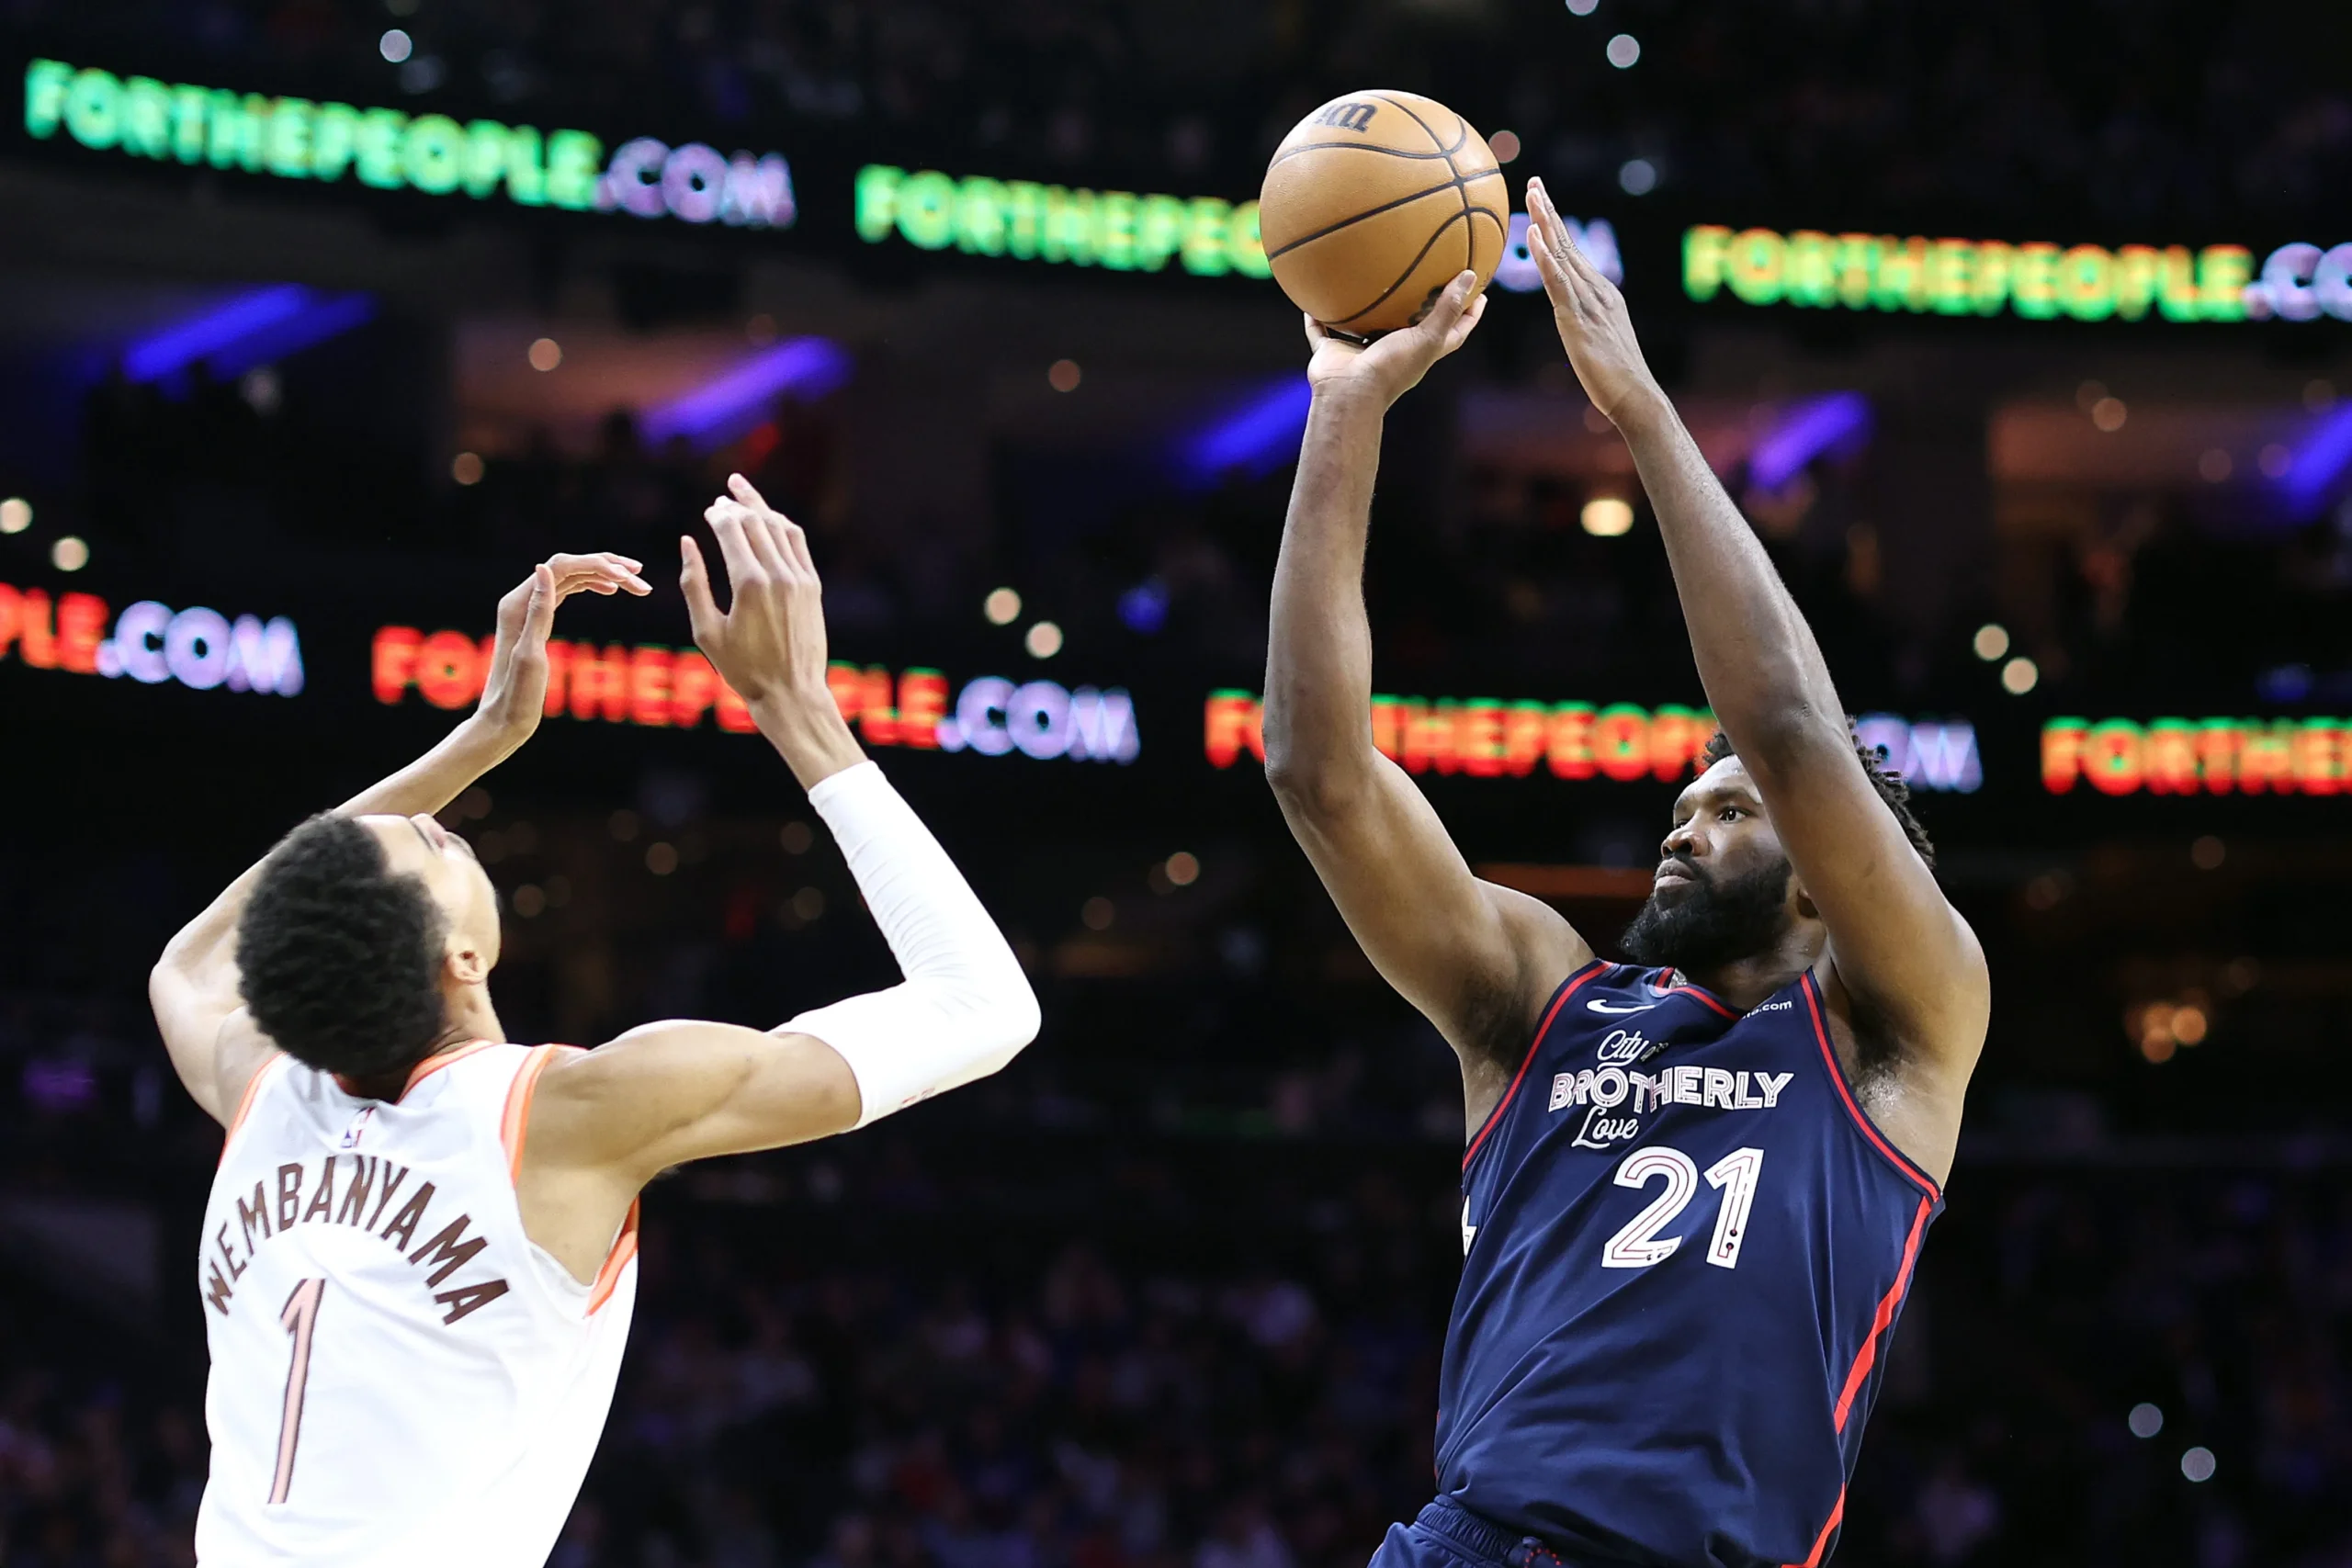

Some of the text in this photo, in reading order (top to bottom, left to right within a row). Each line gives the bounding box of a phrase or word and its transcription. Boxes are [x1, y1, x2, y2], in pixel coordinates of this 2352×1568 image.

[25, 59, 797, 228] FORTHEPEOPLE.COM
[2041, 716, 2352, 795] FORTHE
[1548, 1066, 1794, 1114] BROTHERLY
[1597, 1030, 1649, 1071] City
[1571, 1105, 1639, 1149] Love
[207, 1154, 510, 1325] WEMBANYAMA
[1601, 1146, 1764, 1269] 21
[267, 1278, 327, 1505] 1
